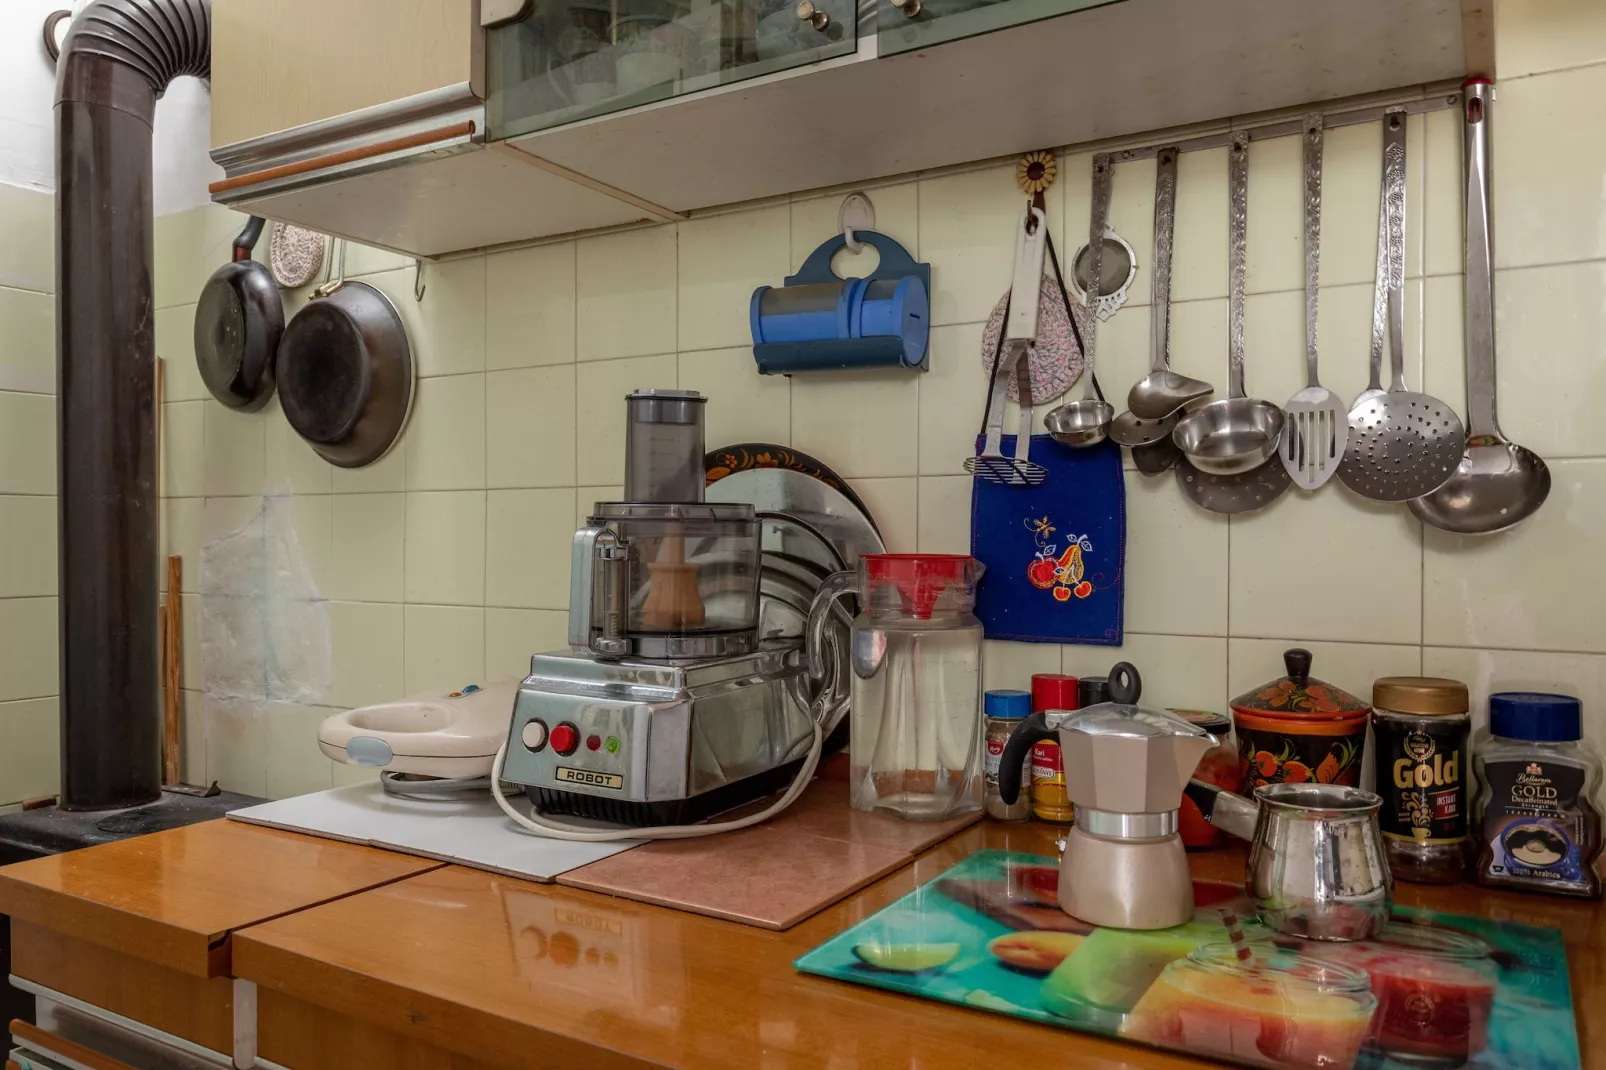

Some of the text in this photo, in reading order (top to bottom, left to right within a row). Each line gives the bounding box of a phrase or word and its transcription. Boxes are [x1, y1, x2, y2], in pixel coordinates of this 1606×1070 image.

[1034, 748, 1045, 757] Kari
[1393, 750, 1459, 789] Gold
[567, 770, 613, 785] ROBOT
[1516, 772, 1552, 786] Bellarom
[1511, 785, 1557, 799] GOLD
[1436, 794, 1457, 806] INSTANT
[1511, 795, 1558, 806] Decaffeinated
[1512, 867, 1531, 876] 100%
[1533, 869, 1561, 879] Arabica
